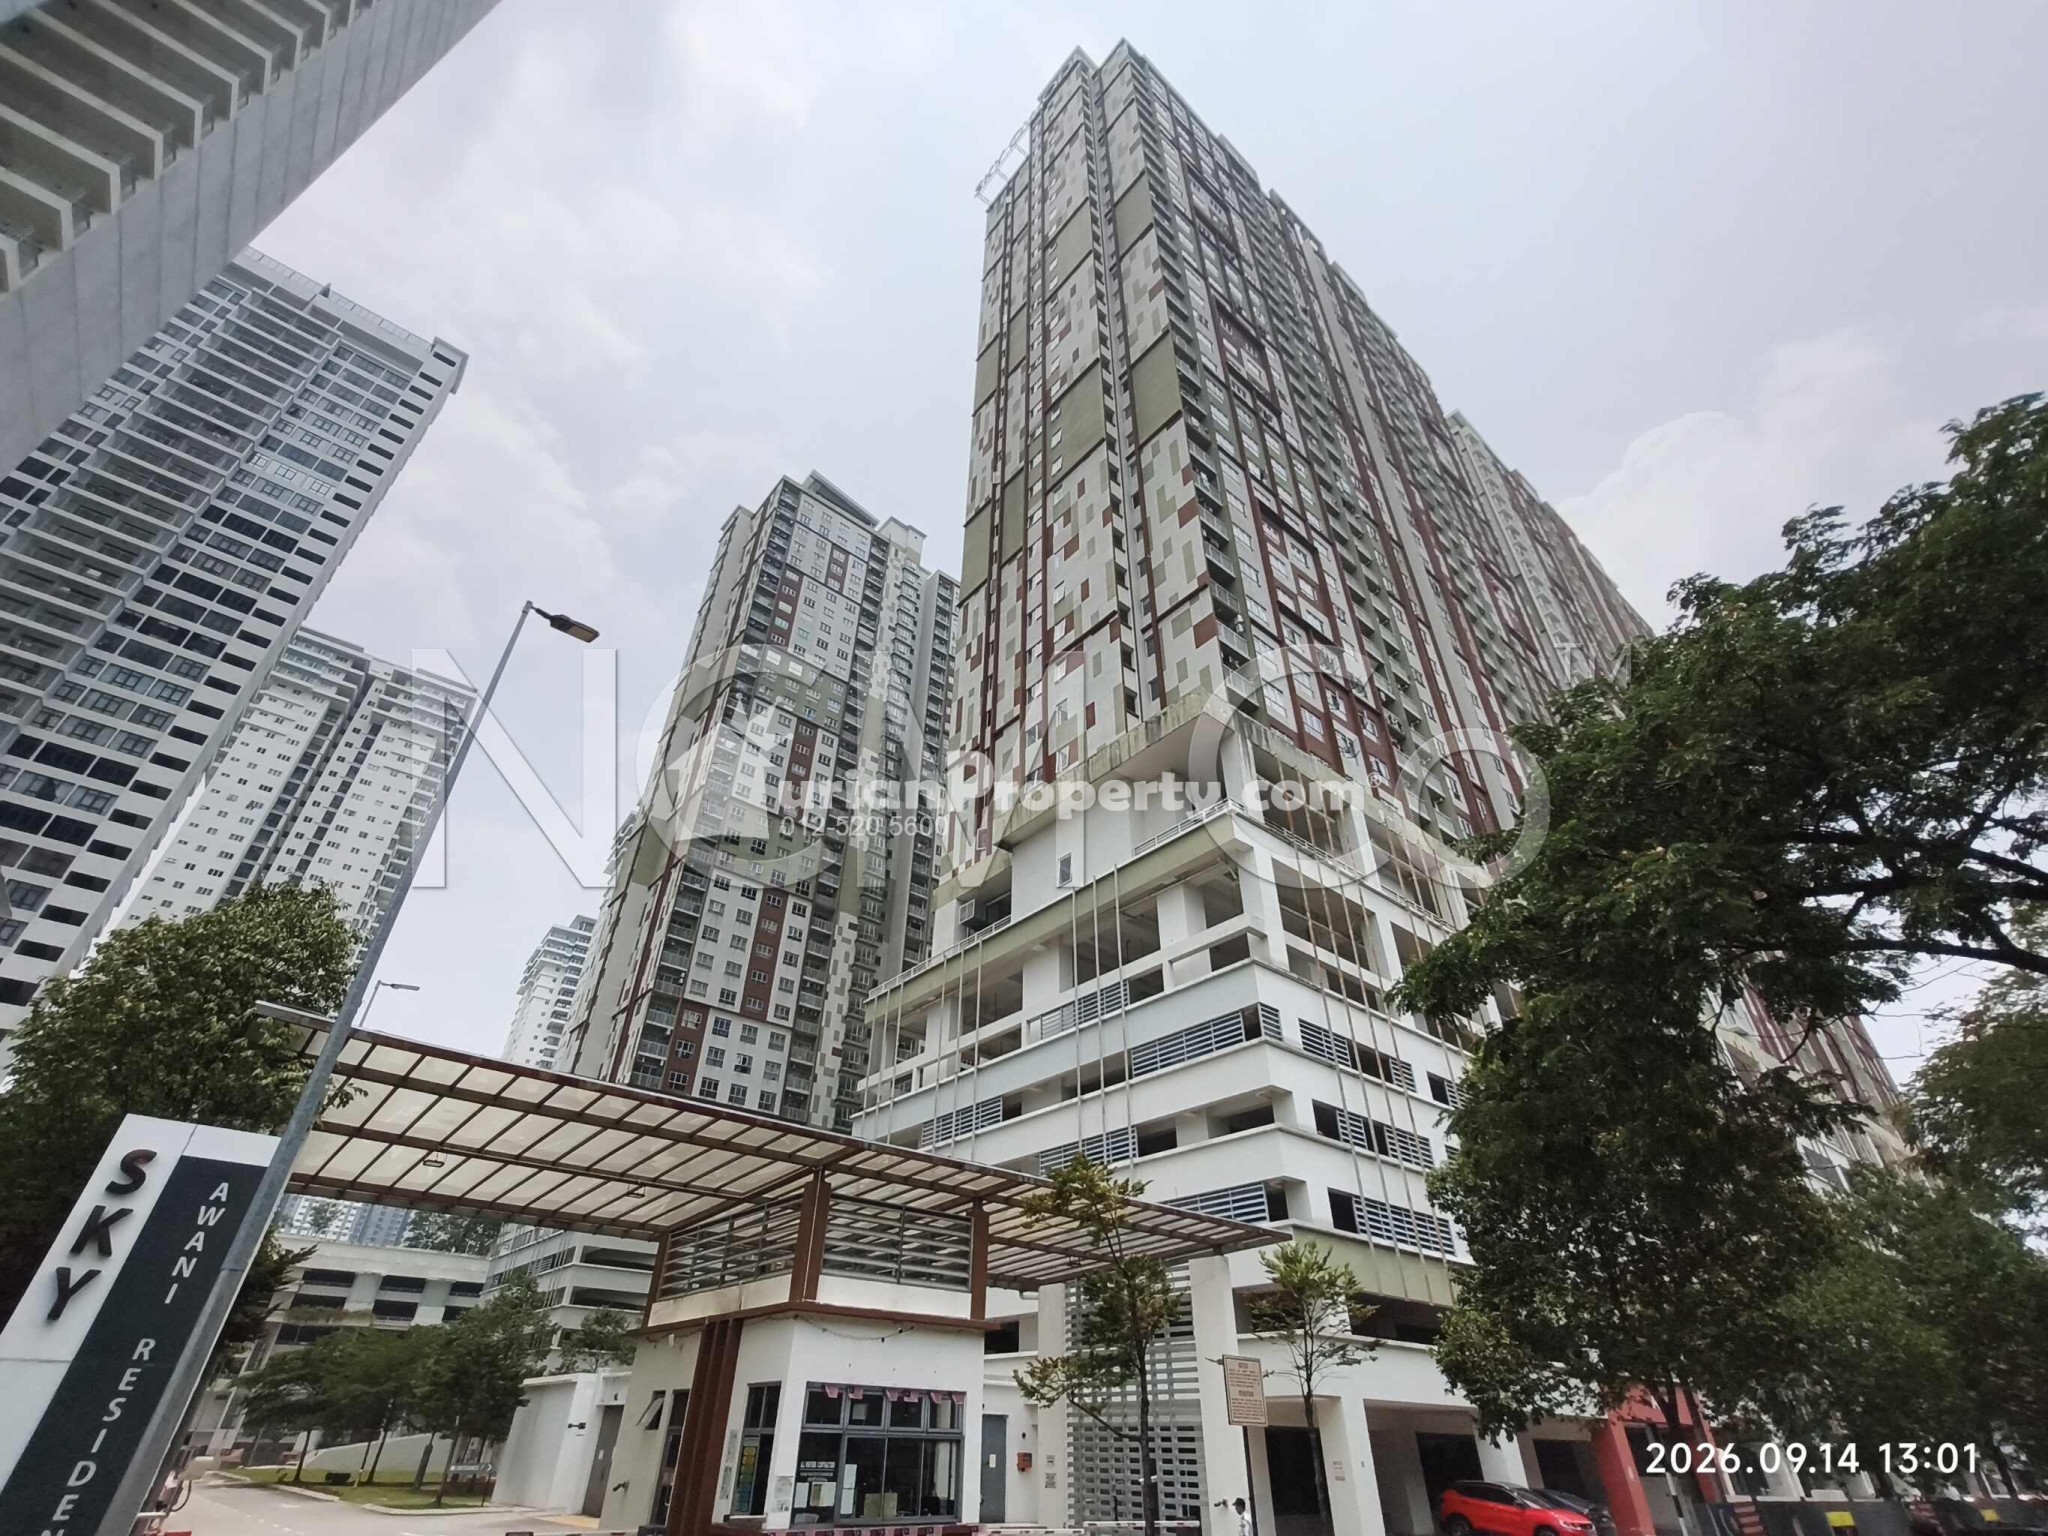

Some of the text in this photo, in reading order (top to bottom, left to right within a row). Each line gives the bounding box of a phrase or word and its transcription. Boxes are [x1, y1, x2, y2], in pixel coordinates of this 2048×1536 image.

[40, 1182, 227, 1536] AWANI RESIDE
[47, 1149, 157, 1321] SKY
